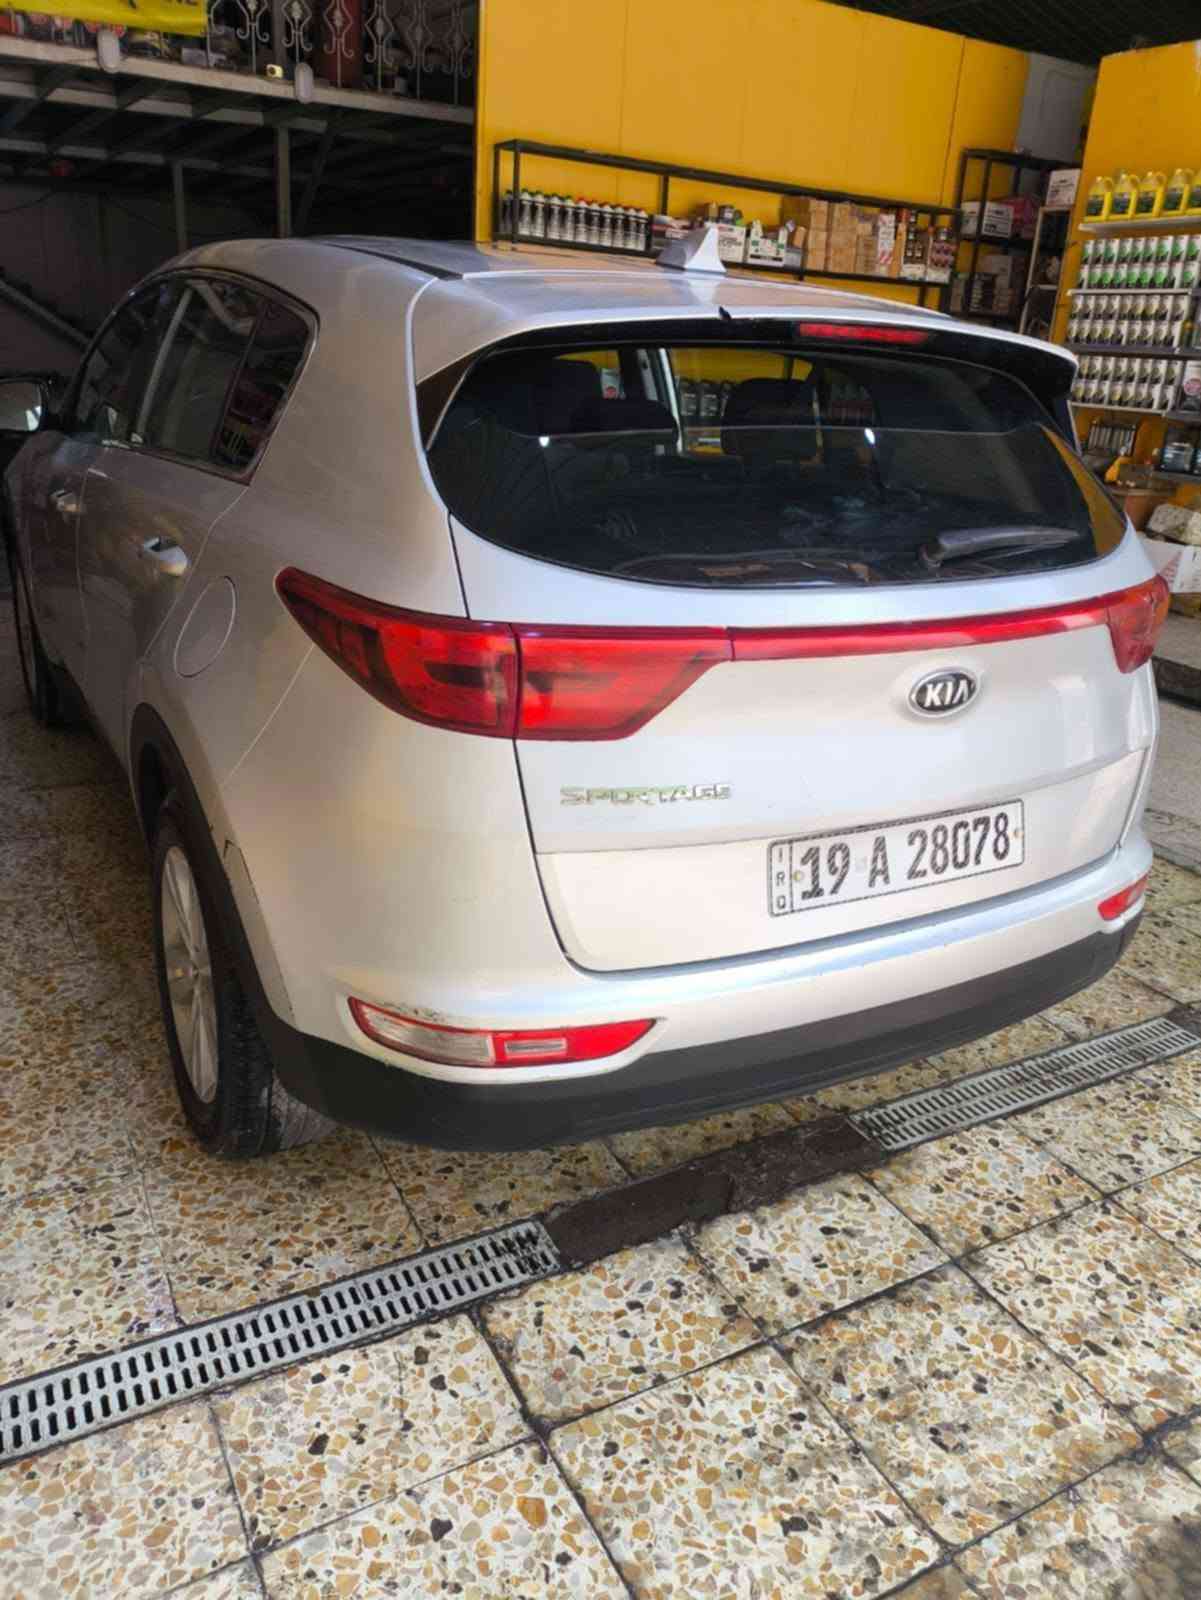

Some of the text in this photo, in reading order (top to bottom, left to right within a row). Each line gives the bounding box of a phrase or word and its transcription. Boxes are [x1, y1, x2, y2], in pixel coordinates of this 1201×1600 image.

[923, 679, 969, 708] KIA
[559, 783, 732, 805] SPORTAGE
[800, 811, 1011, 900] 19 A 28078
